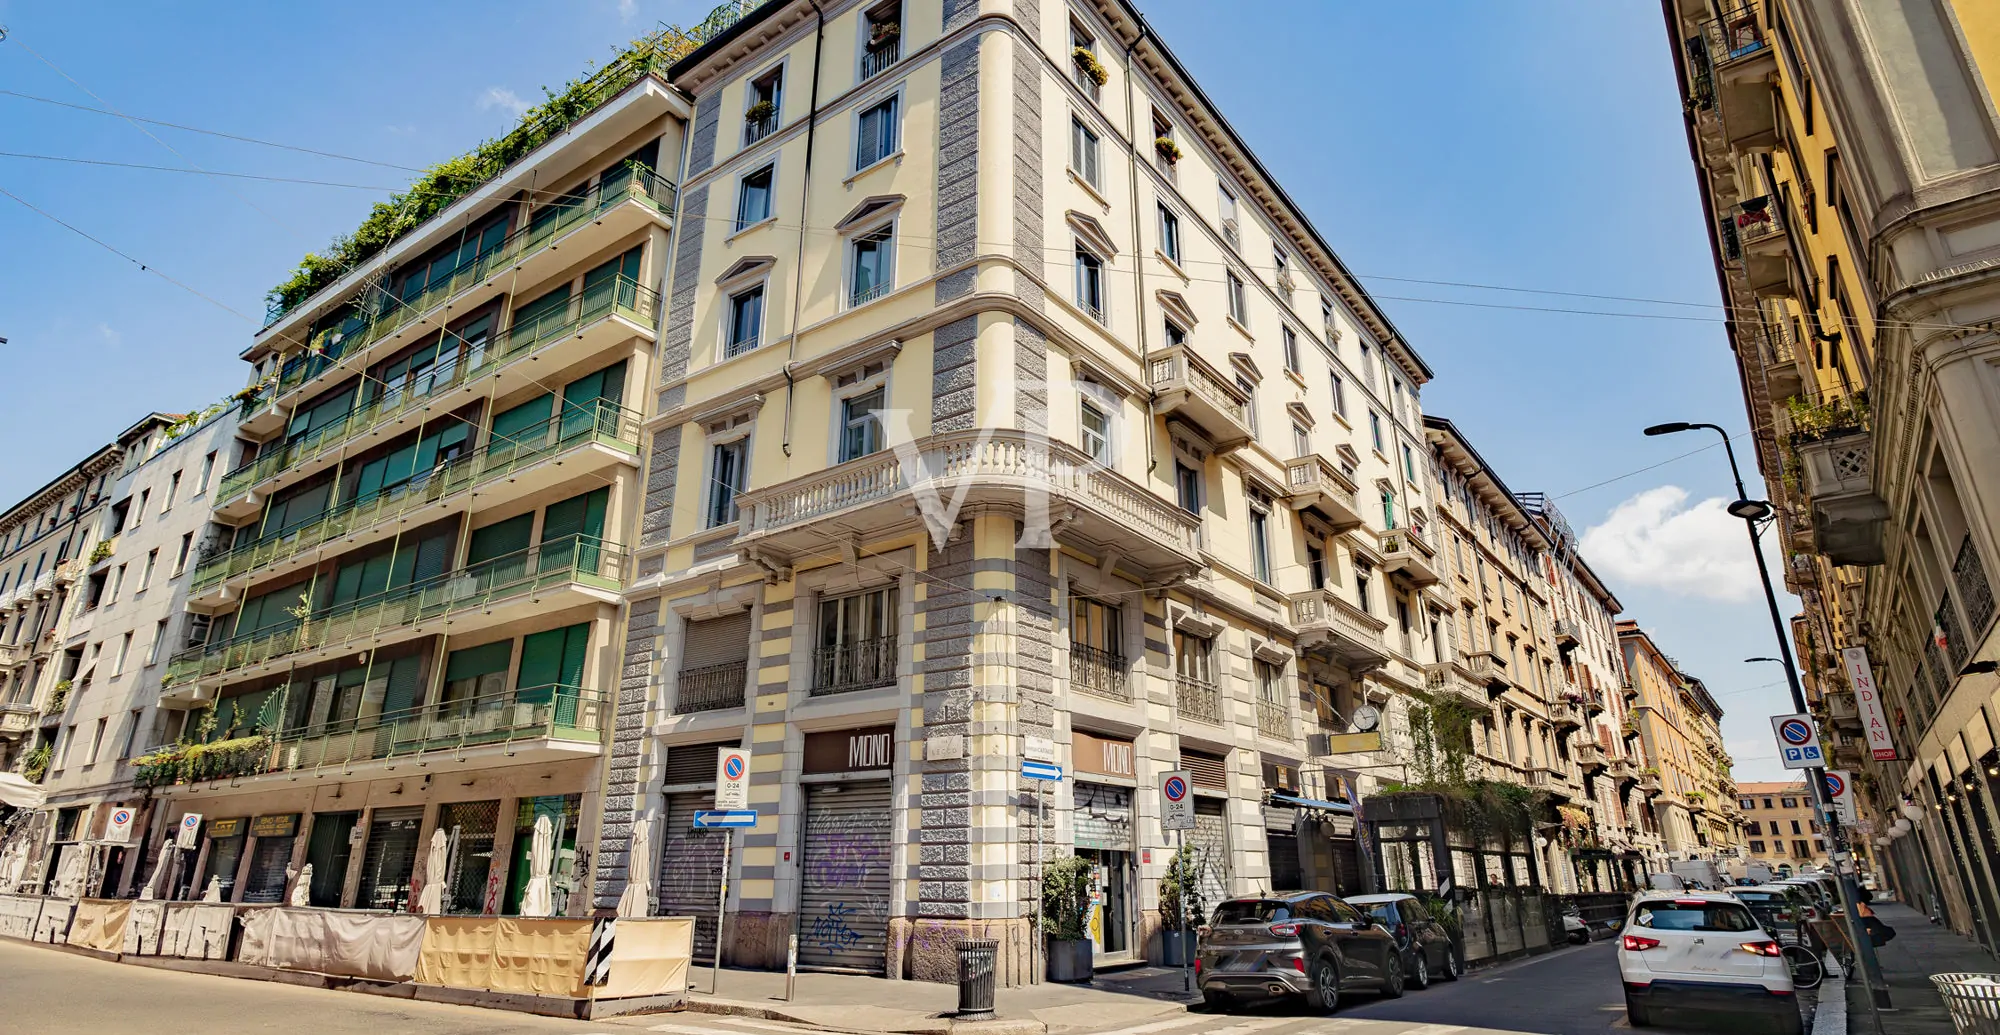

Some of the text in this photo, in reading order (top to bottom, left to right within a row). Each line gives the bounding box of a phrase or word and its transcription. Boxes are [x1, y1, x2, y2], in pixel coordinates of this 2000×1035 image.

[1856, 664, 1886, 742] INDIAN
[849, 733, 891, 768] MONO
[931, 746, 958, 757] LECCO
[1103, 741, 1131, 775] MONO
[1789, 750, 1798, 759] P
